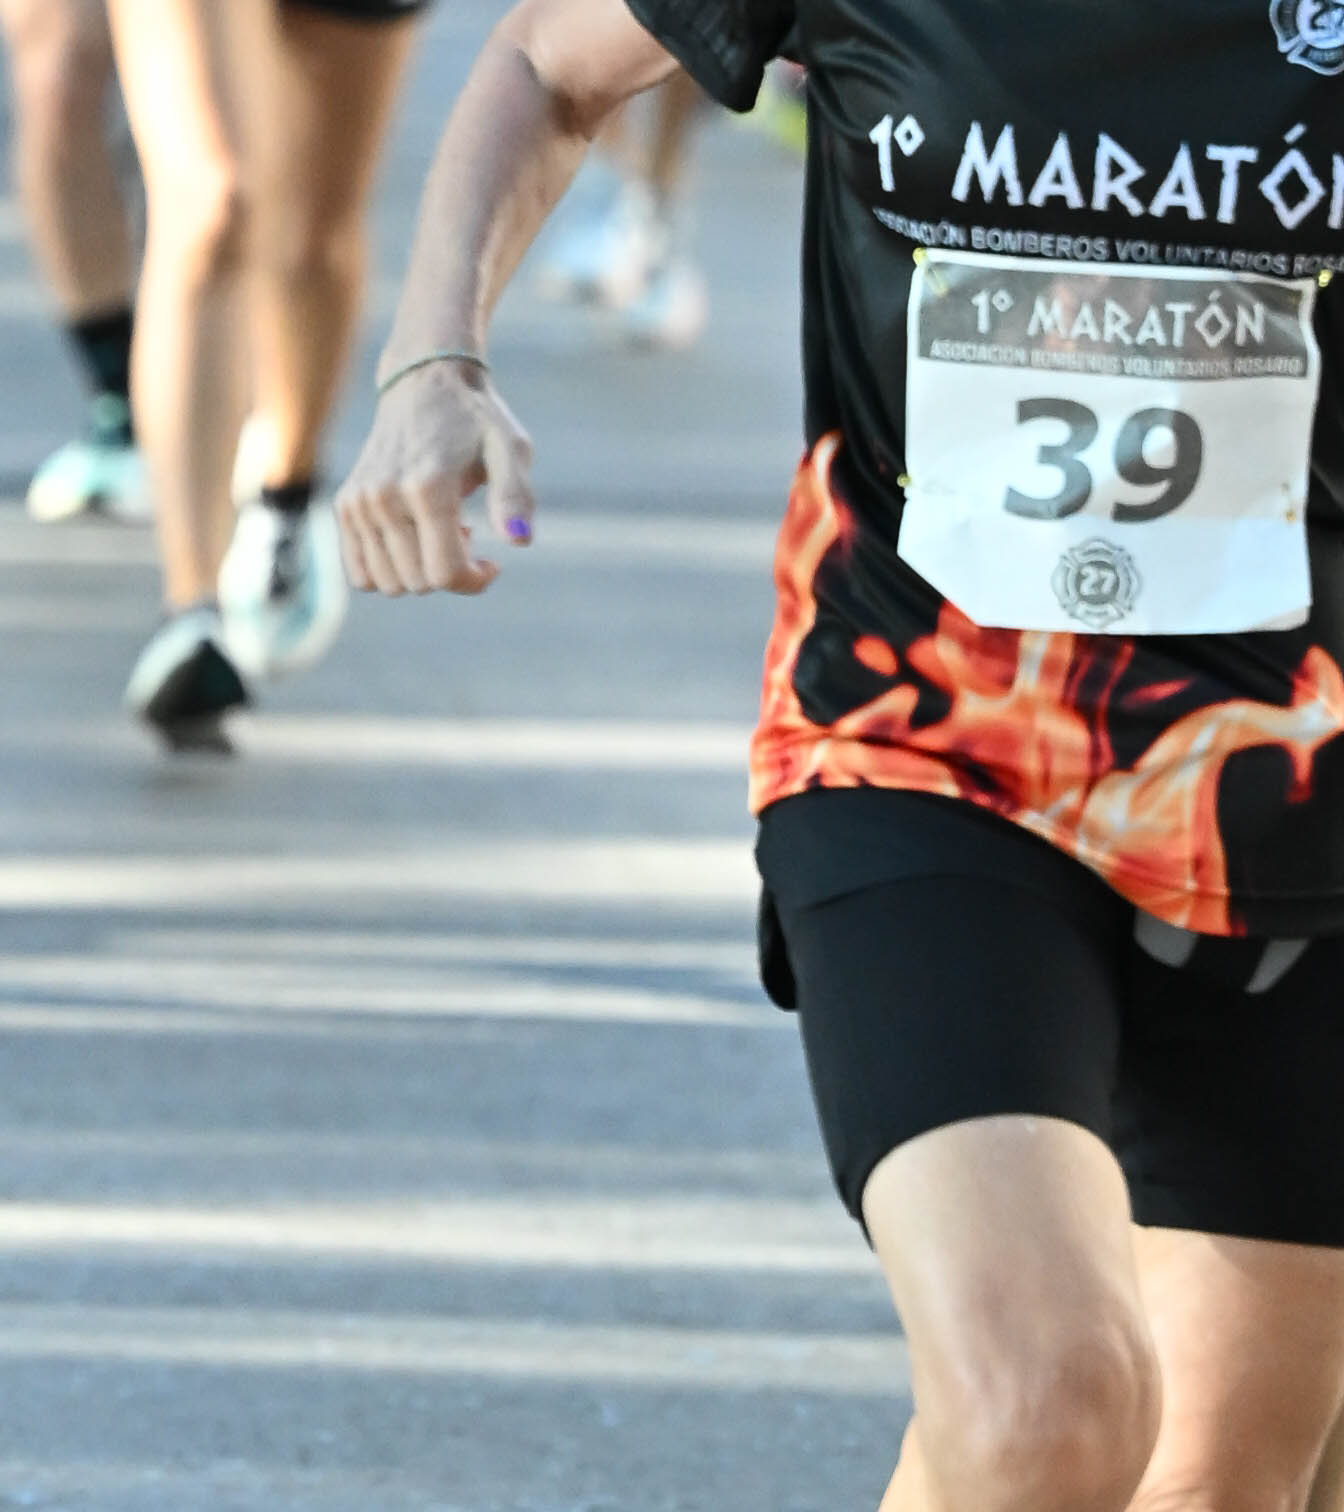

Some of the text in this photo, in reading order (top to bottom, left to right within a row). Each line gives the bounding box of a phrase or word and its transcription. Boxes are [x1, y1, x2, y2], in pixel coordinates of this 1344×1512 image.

[970, 224, 1111, 261] BOMBEROS
[1026, 290, 1266, 349] MARATÓN
[1004, 397, 1203, 522] 39
[1079, 564, 1115, 597] 27
